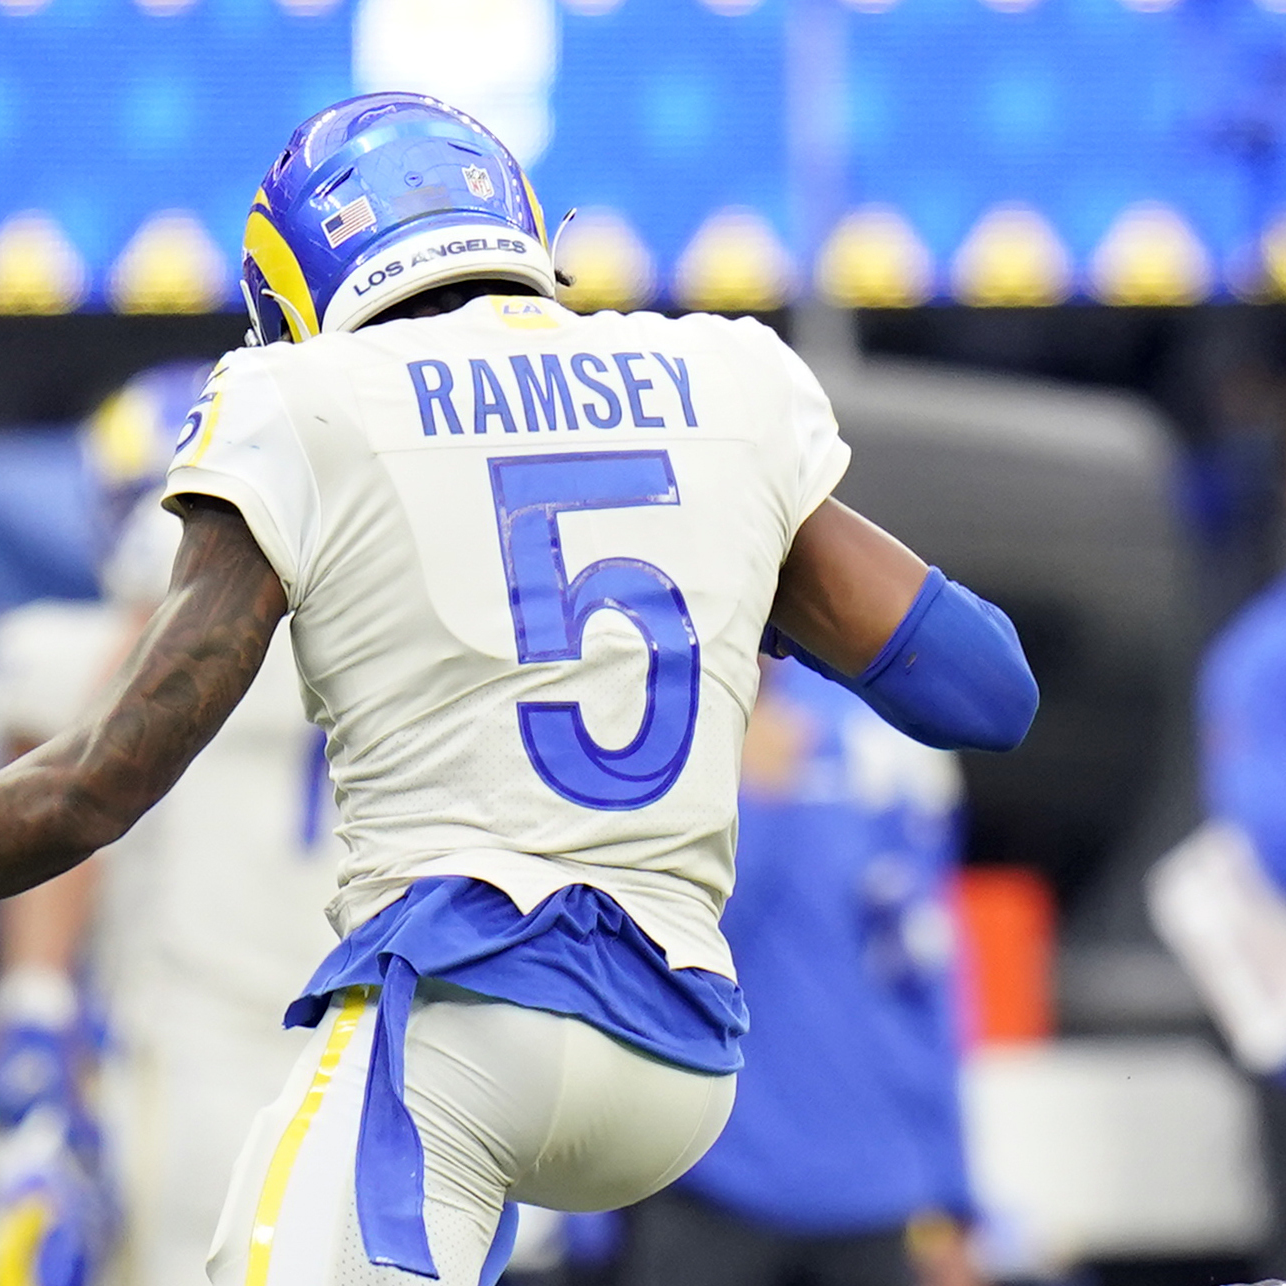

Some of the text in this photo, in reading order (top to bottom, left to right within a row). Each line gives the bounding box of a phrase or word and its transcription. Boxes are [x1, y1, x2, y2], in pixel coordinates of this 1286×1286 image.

[353, 238, 527, 297] LOS ANGELES
[503, 304, 543, 315] LA
[406, 351, 699, 436] RAMSEY
[486, 449, 701, 812] 5
